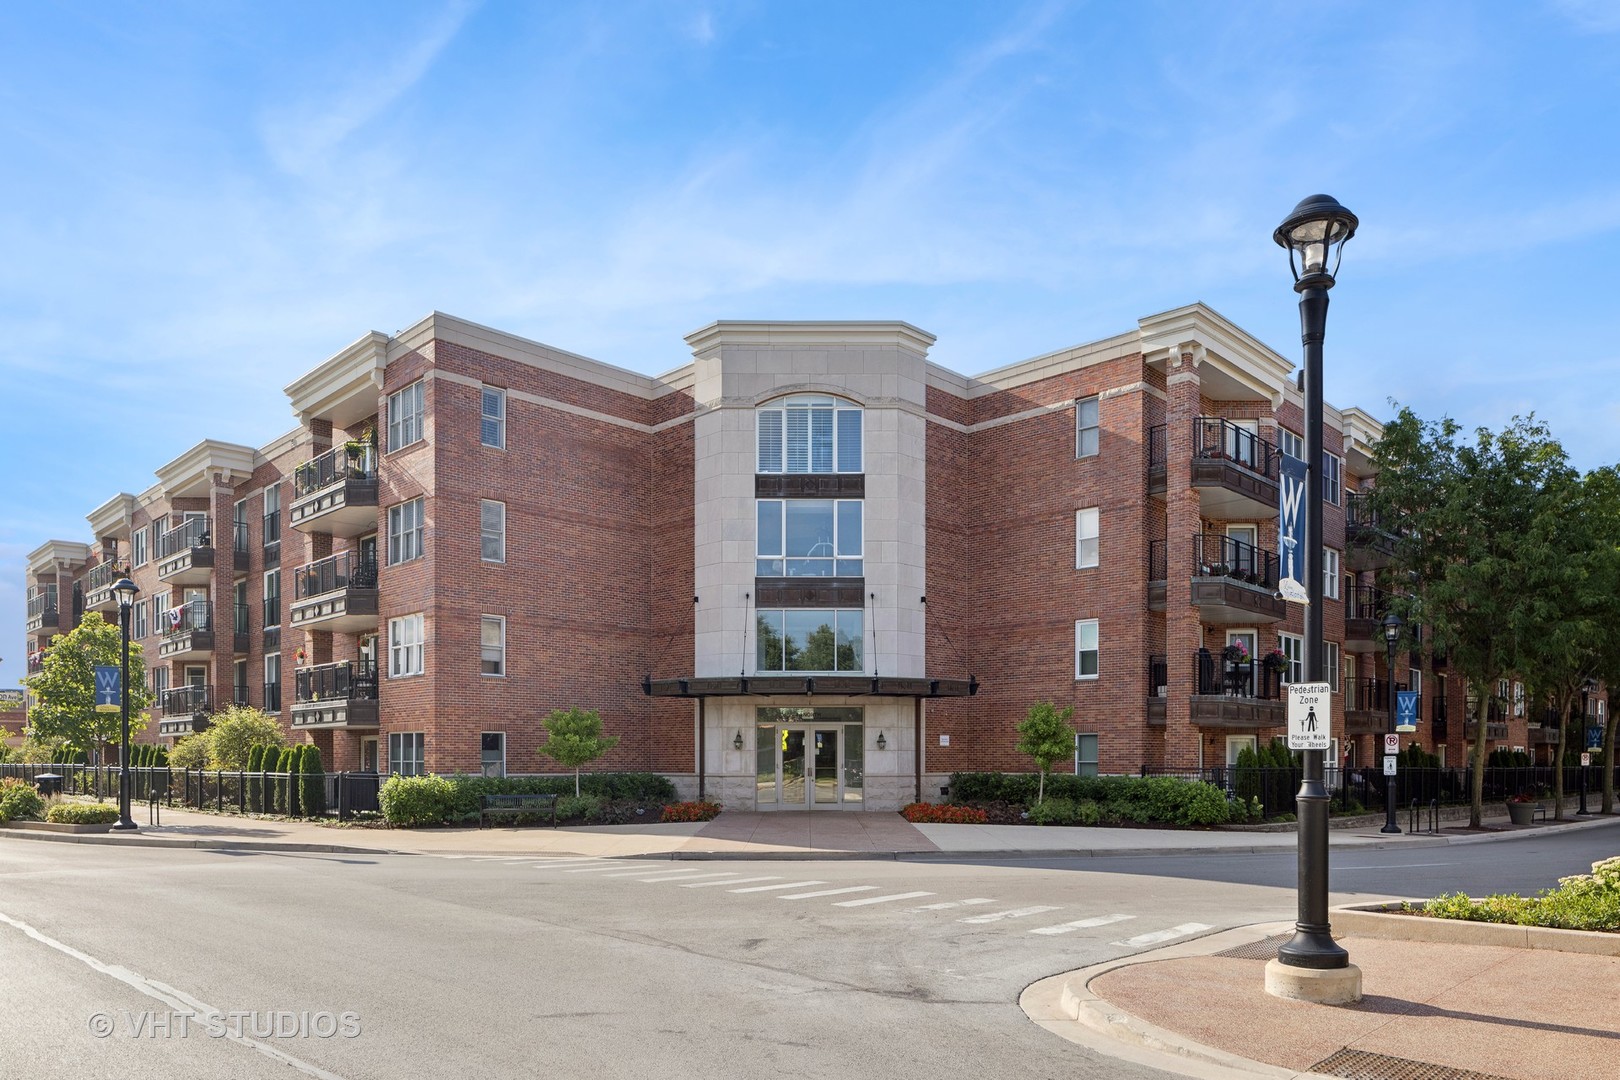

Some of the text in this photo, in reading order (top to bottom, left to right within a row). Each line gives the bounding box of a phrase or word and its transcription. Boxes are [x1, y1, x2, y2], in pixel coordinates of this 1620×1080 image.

[1280, 473, 1304, 529] W
[97, 672, 118, 688] W
[1290, 685, 1329, 694] Pedestrian
[1300, 696, 1318, 704] Zone
[1398, 696, 1416, 711] W
